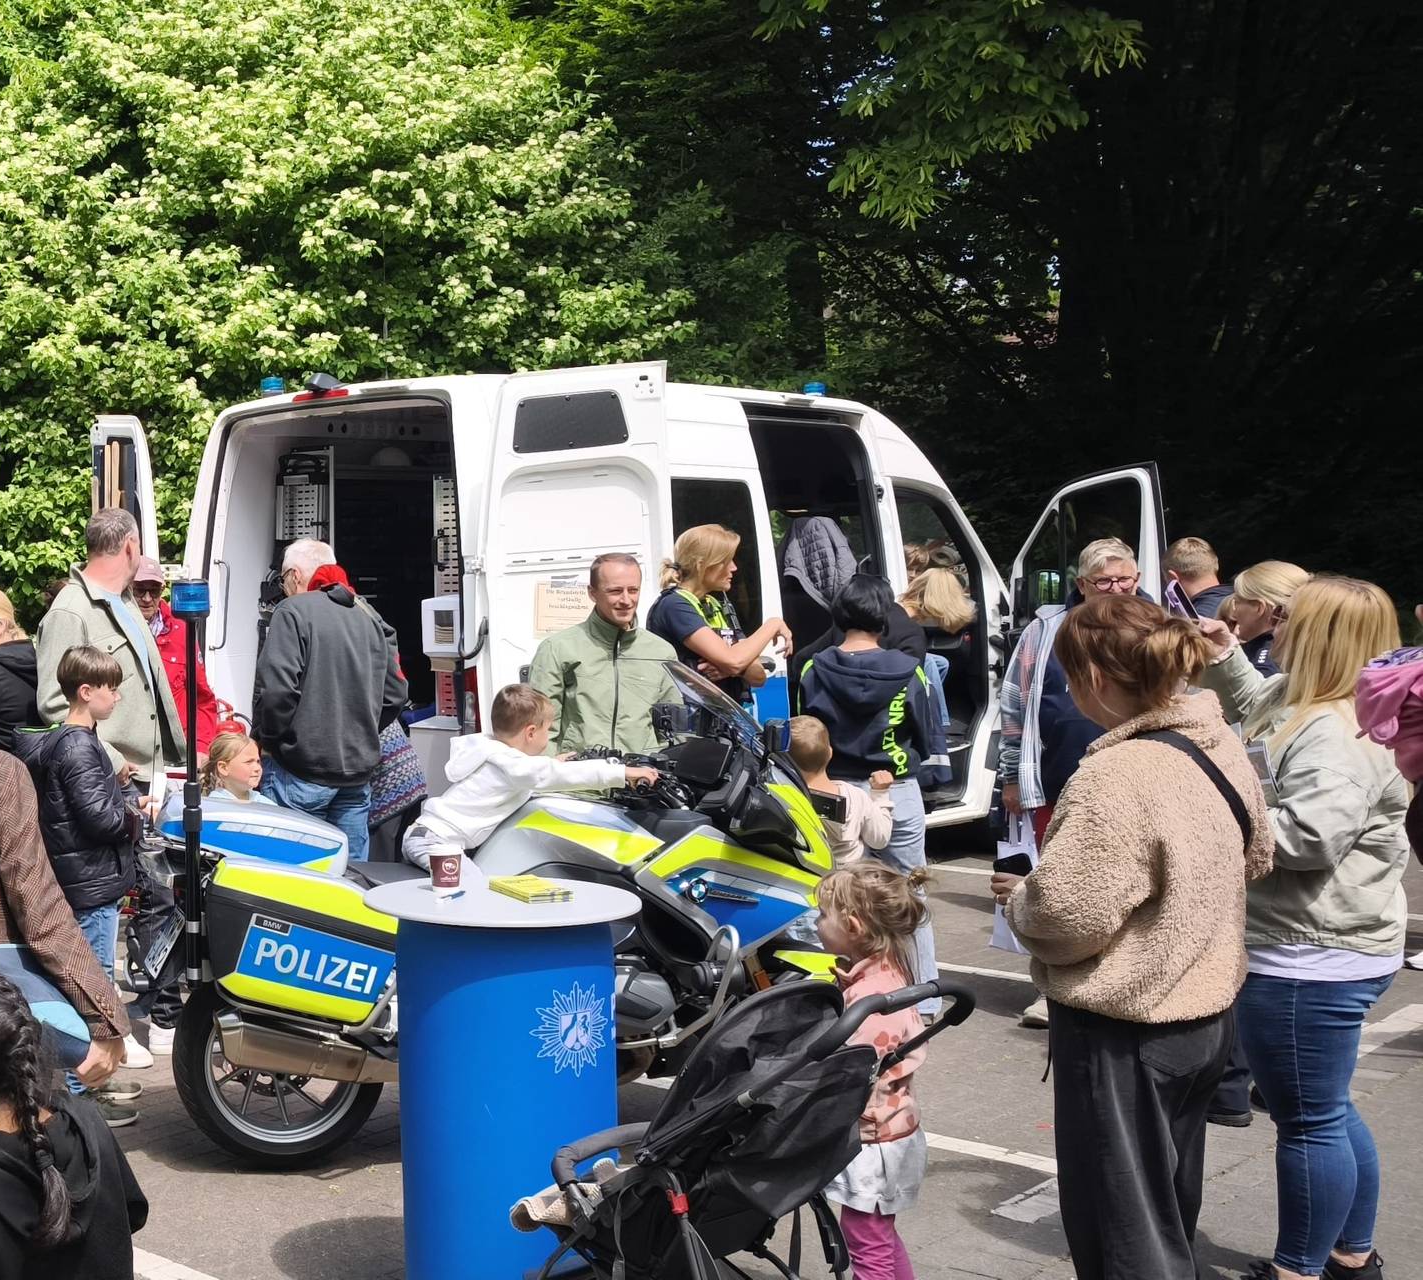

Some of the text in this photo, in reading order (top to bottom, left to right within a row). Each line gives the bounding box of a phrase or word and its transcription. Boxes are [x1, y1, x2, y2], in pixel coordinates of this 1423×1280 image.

[882, 727, 909, 776] POLIZ
[262, 919, 282, 930] BMW
[253, 937, 378, 994] POLIZEI
